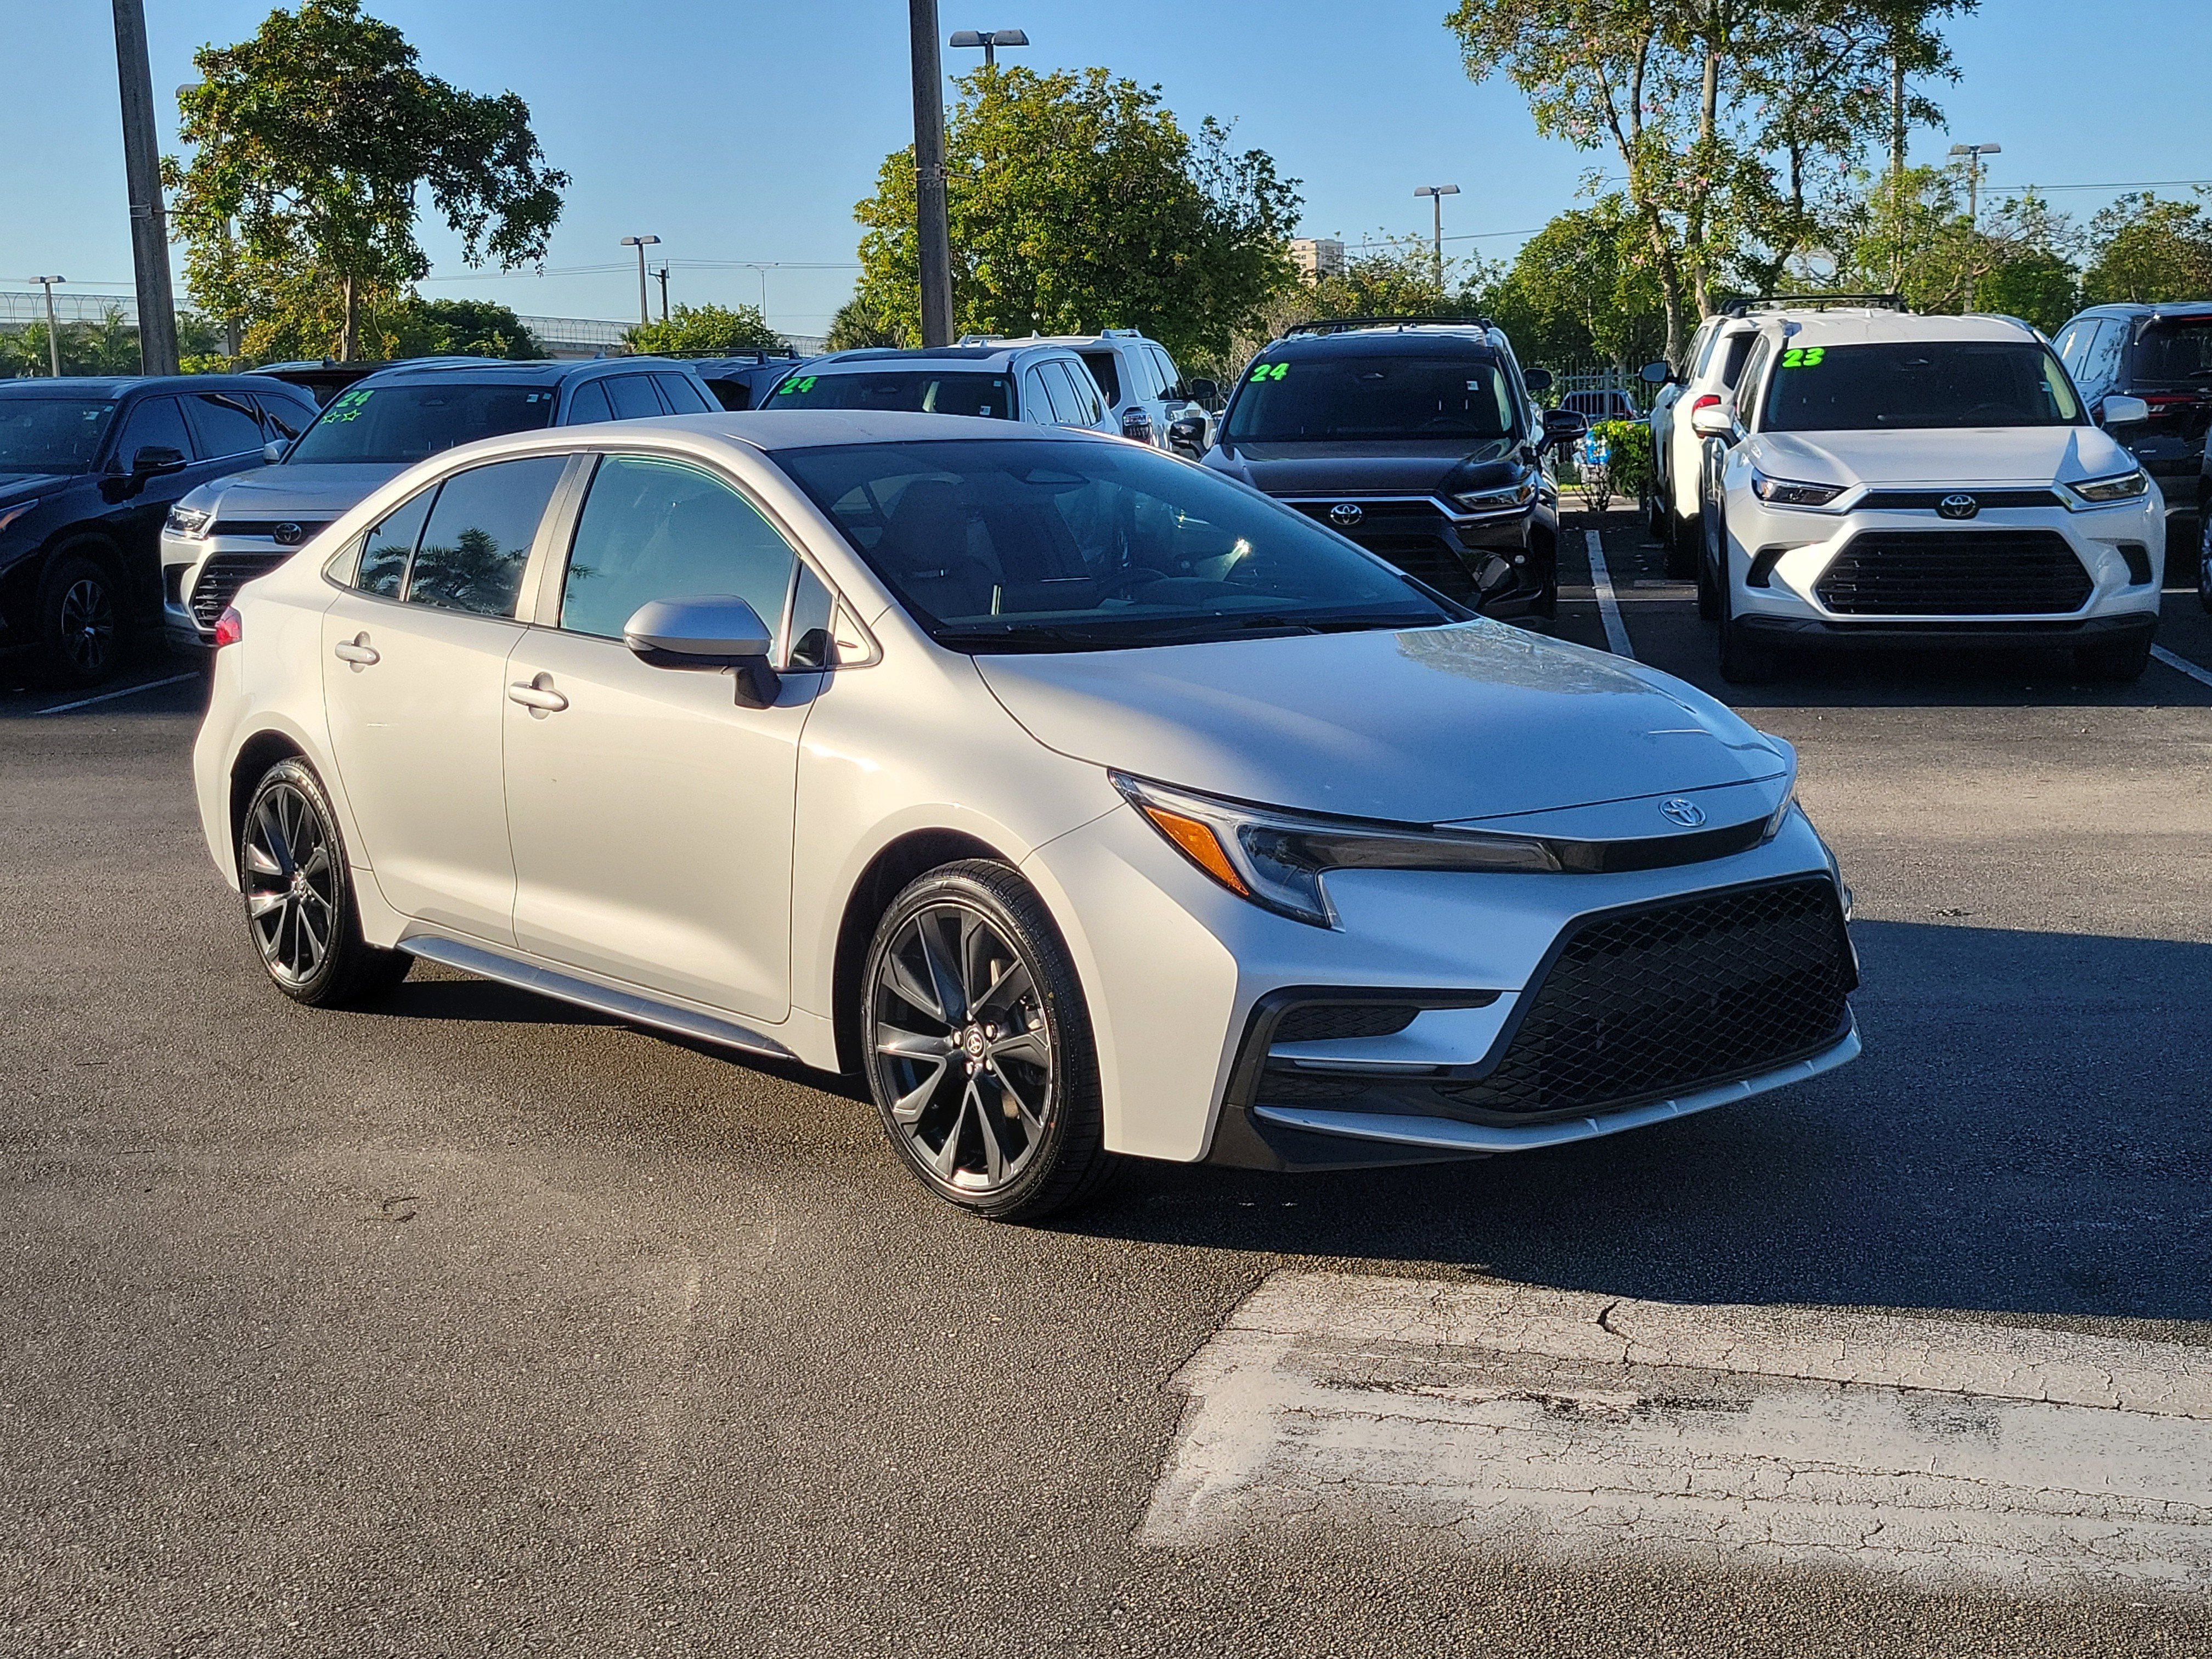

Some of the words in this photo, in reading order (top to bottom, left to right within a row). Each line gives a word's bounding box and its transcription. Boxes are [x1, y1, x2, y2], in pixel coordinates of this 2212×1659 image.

[1782, 347, 1825, 368] 23
[1250, 363, 1290, 382] 24
[779, 376, 819, 395] 24
[336, 390, 375, 408] 24
